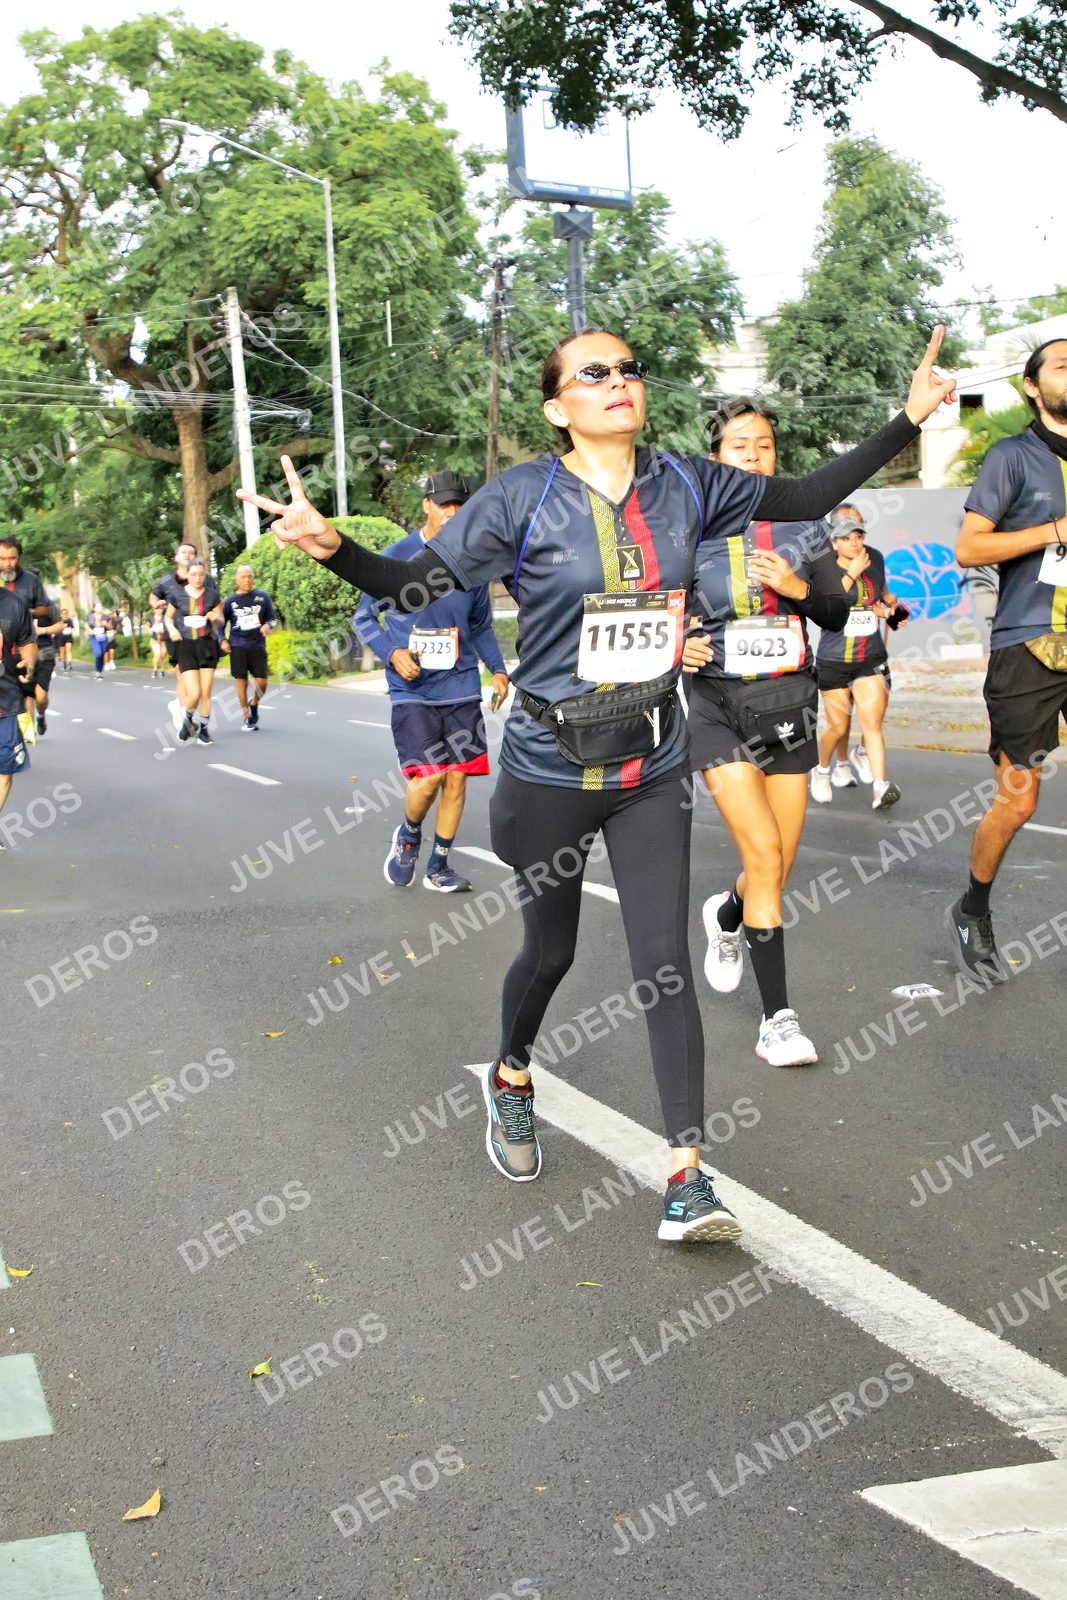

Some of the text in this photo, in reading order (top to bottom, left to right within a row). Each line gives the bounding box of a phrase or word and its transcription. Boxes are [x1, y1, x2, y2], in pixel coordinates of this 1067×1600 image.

[588, 621, 668, 651] 11555
[413, 641, 451, 654] 12325
[737, 637, 787, 657] 9623
